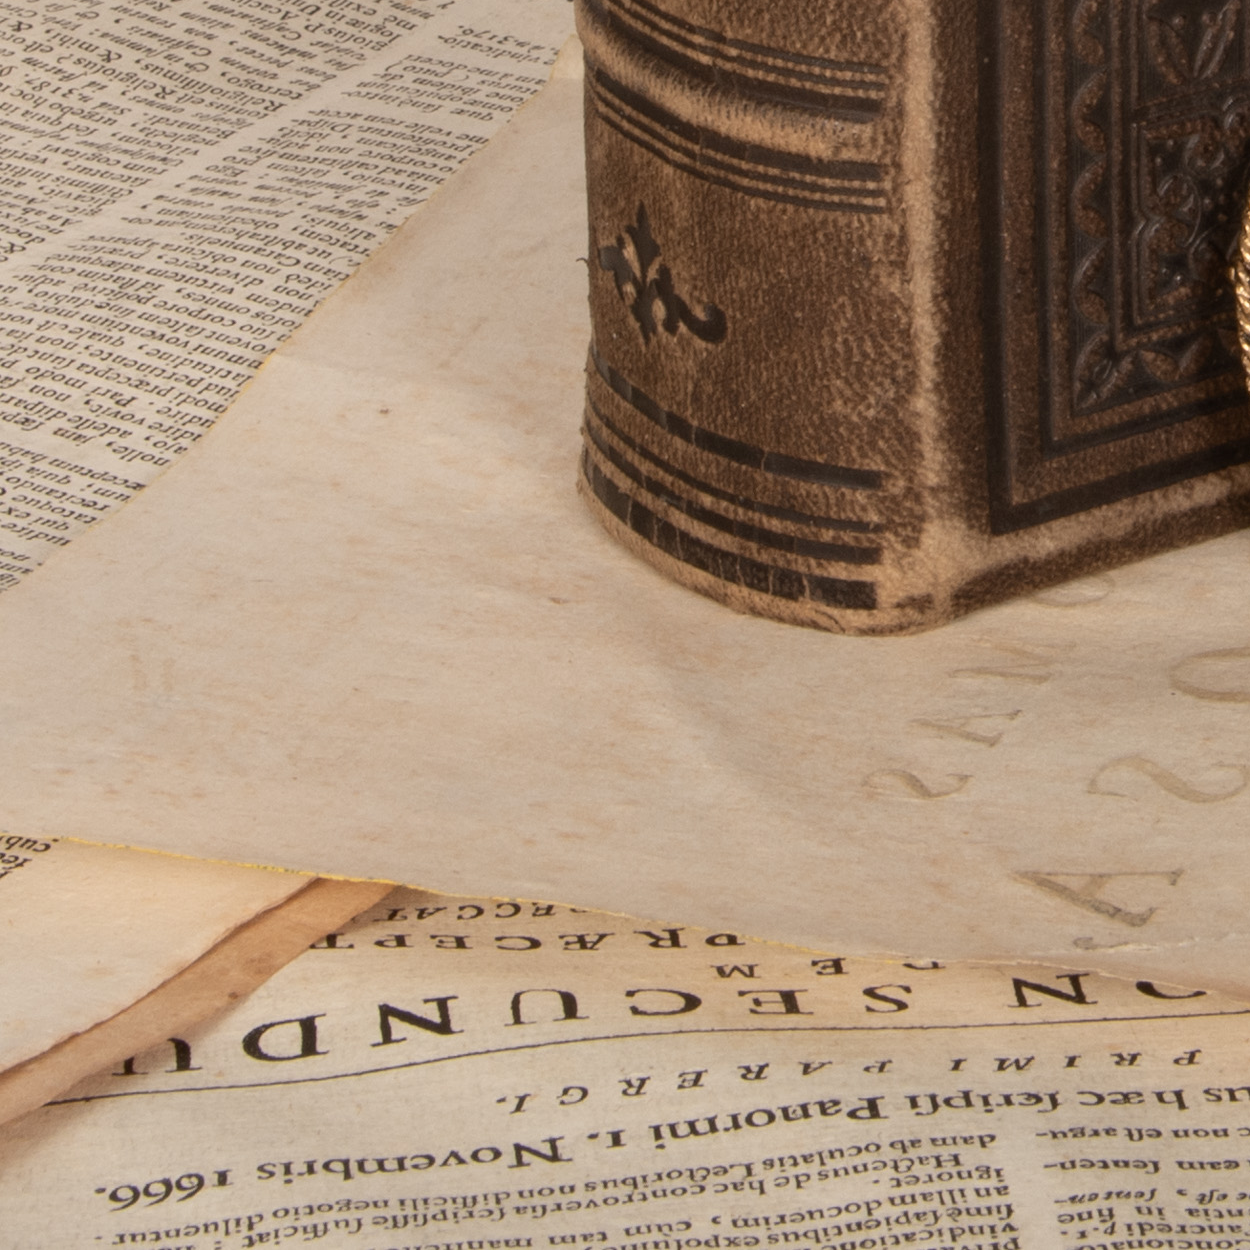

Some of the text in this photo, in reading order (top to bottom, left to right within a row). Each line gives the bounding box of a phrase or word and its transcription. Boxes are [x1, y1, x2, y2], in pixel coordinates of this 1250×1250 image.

[948, 1049, 1203, 1073] PRIMI
[648, 1095, 891, 1151] Panormi
[255, 1135, 574, 1184] Novembris
[93, 1168, 234, 1213] 1666.
